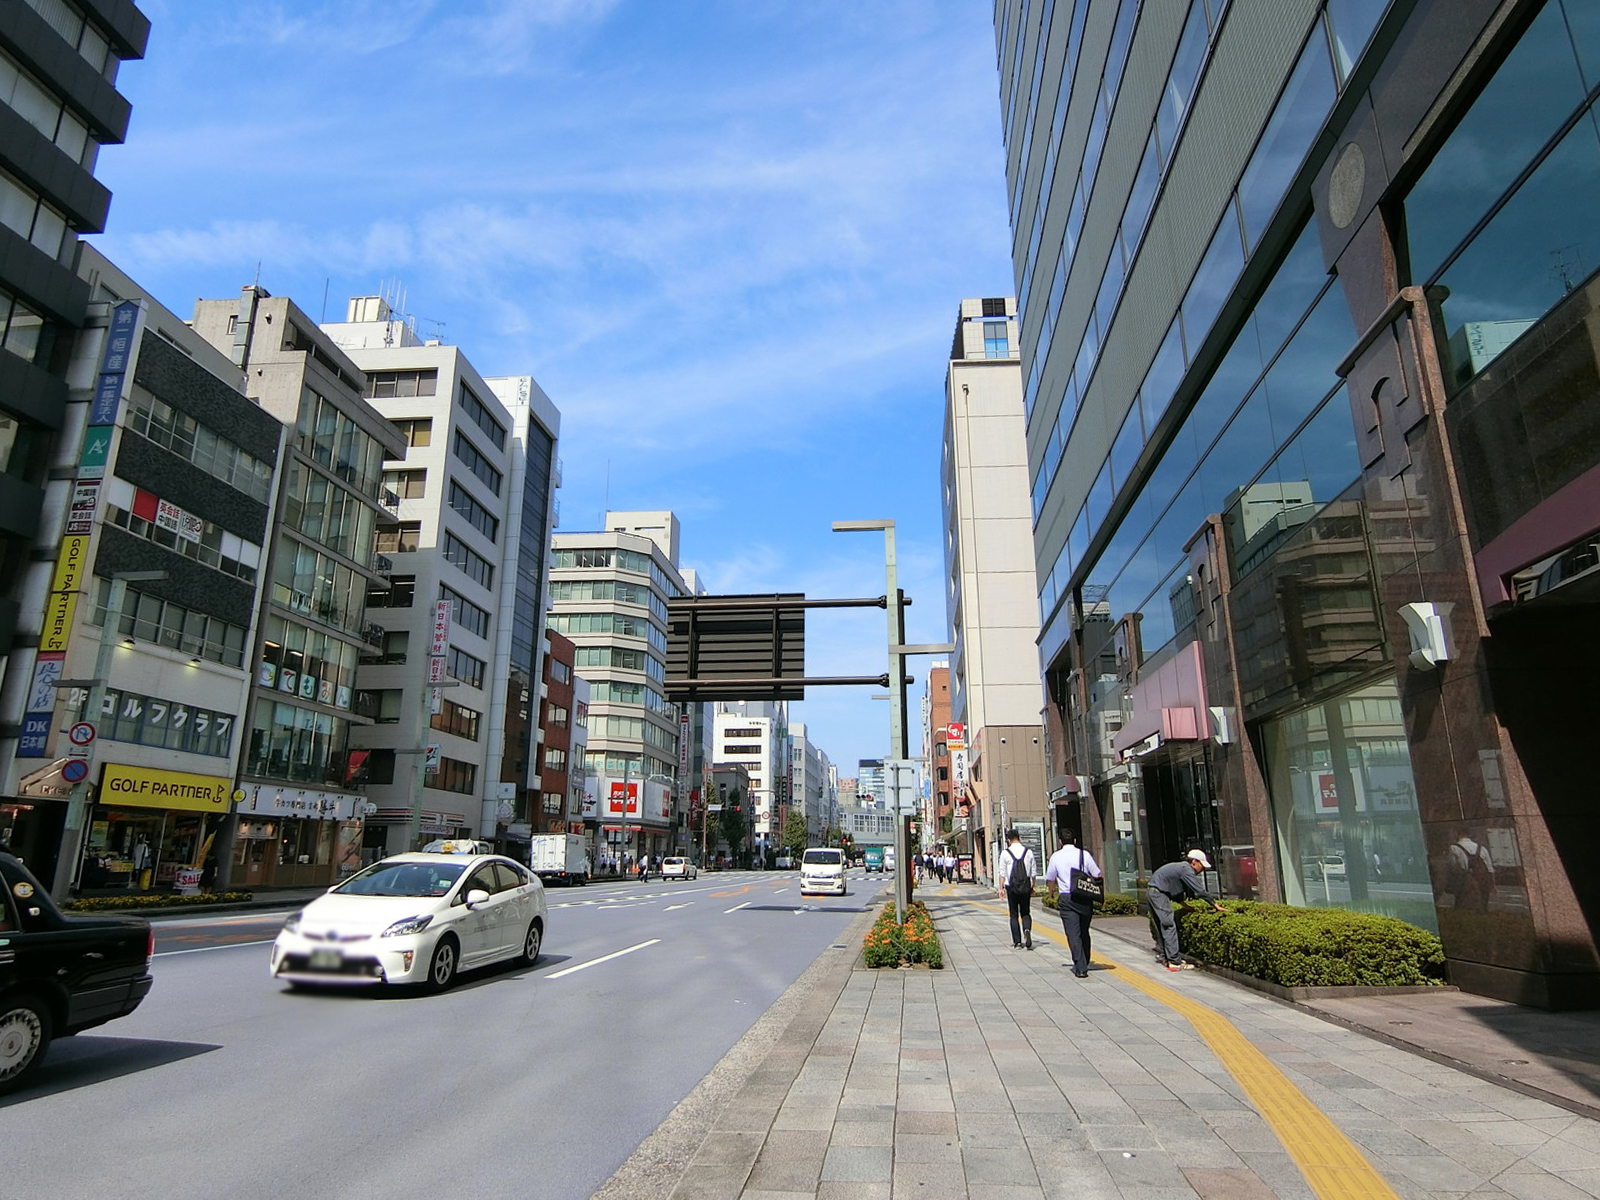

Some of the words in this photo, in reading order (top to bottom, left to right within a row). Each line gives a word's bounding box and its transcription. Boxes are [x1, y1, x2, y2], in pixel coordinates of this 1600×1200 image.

[108, 309, 133, 369] 第一恒産
[76, 488, 97, 496] 中国語
[71, 511, 93, 520] 英会話
[160, 502, 181, 519] 英会話
[158, 514, 178, 530] 中国語
[67, 538, 81, 570] GOLF
[52, 574, 75, 636] PARTNER
[68, 687, 89, 706] 2F
[101, 692, 232, 736] ゴルフクラブ
[26, 720, 48, 732] DK
[21, 735, 47, 749] 日本橋
[110, 778, 150, 793] GOLF
[151, 782, 212, 799] PARTNER
[182, 873, 201, 885] SALE
